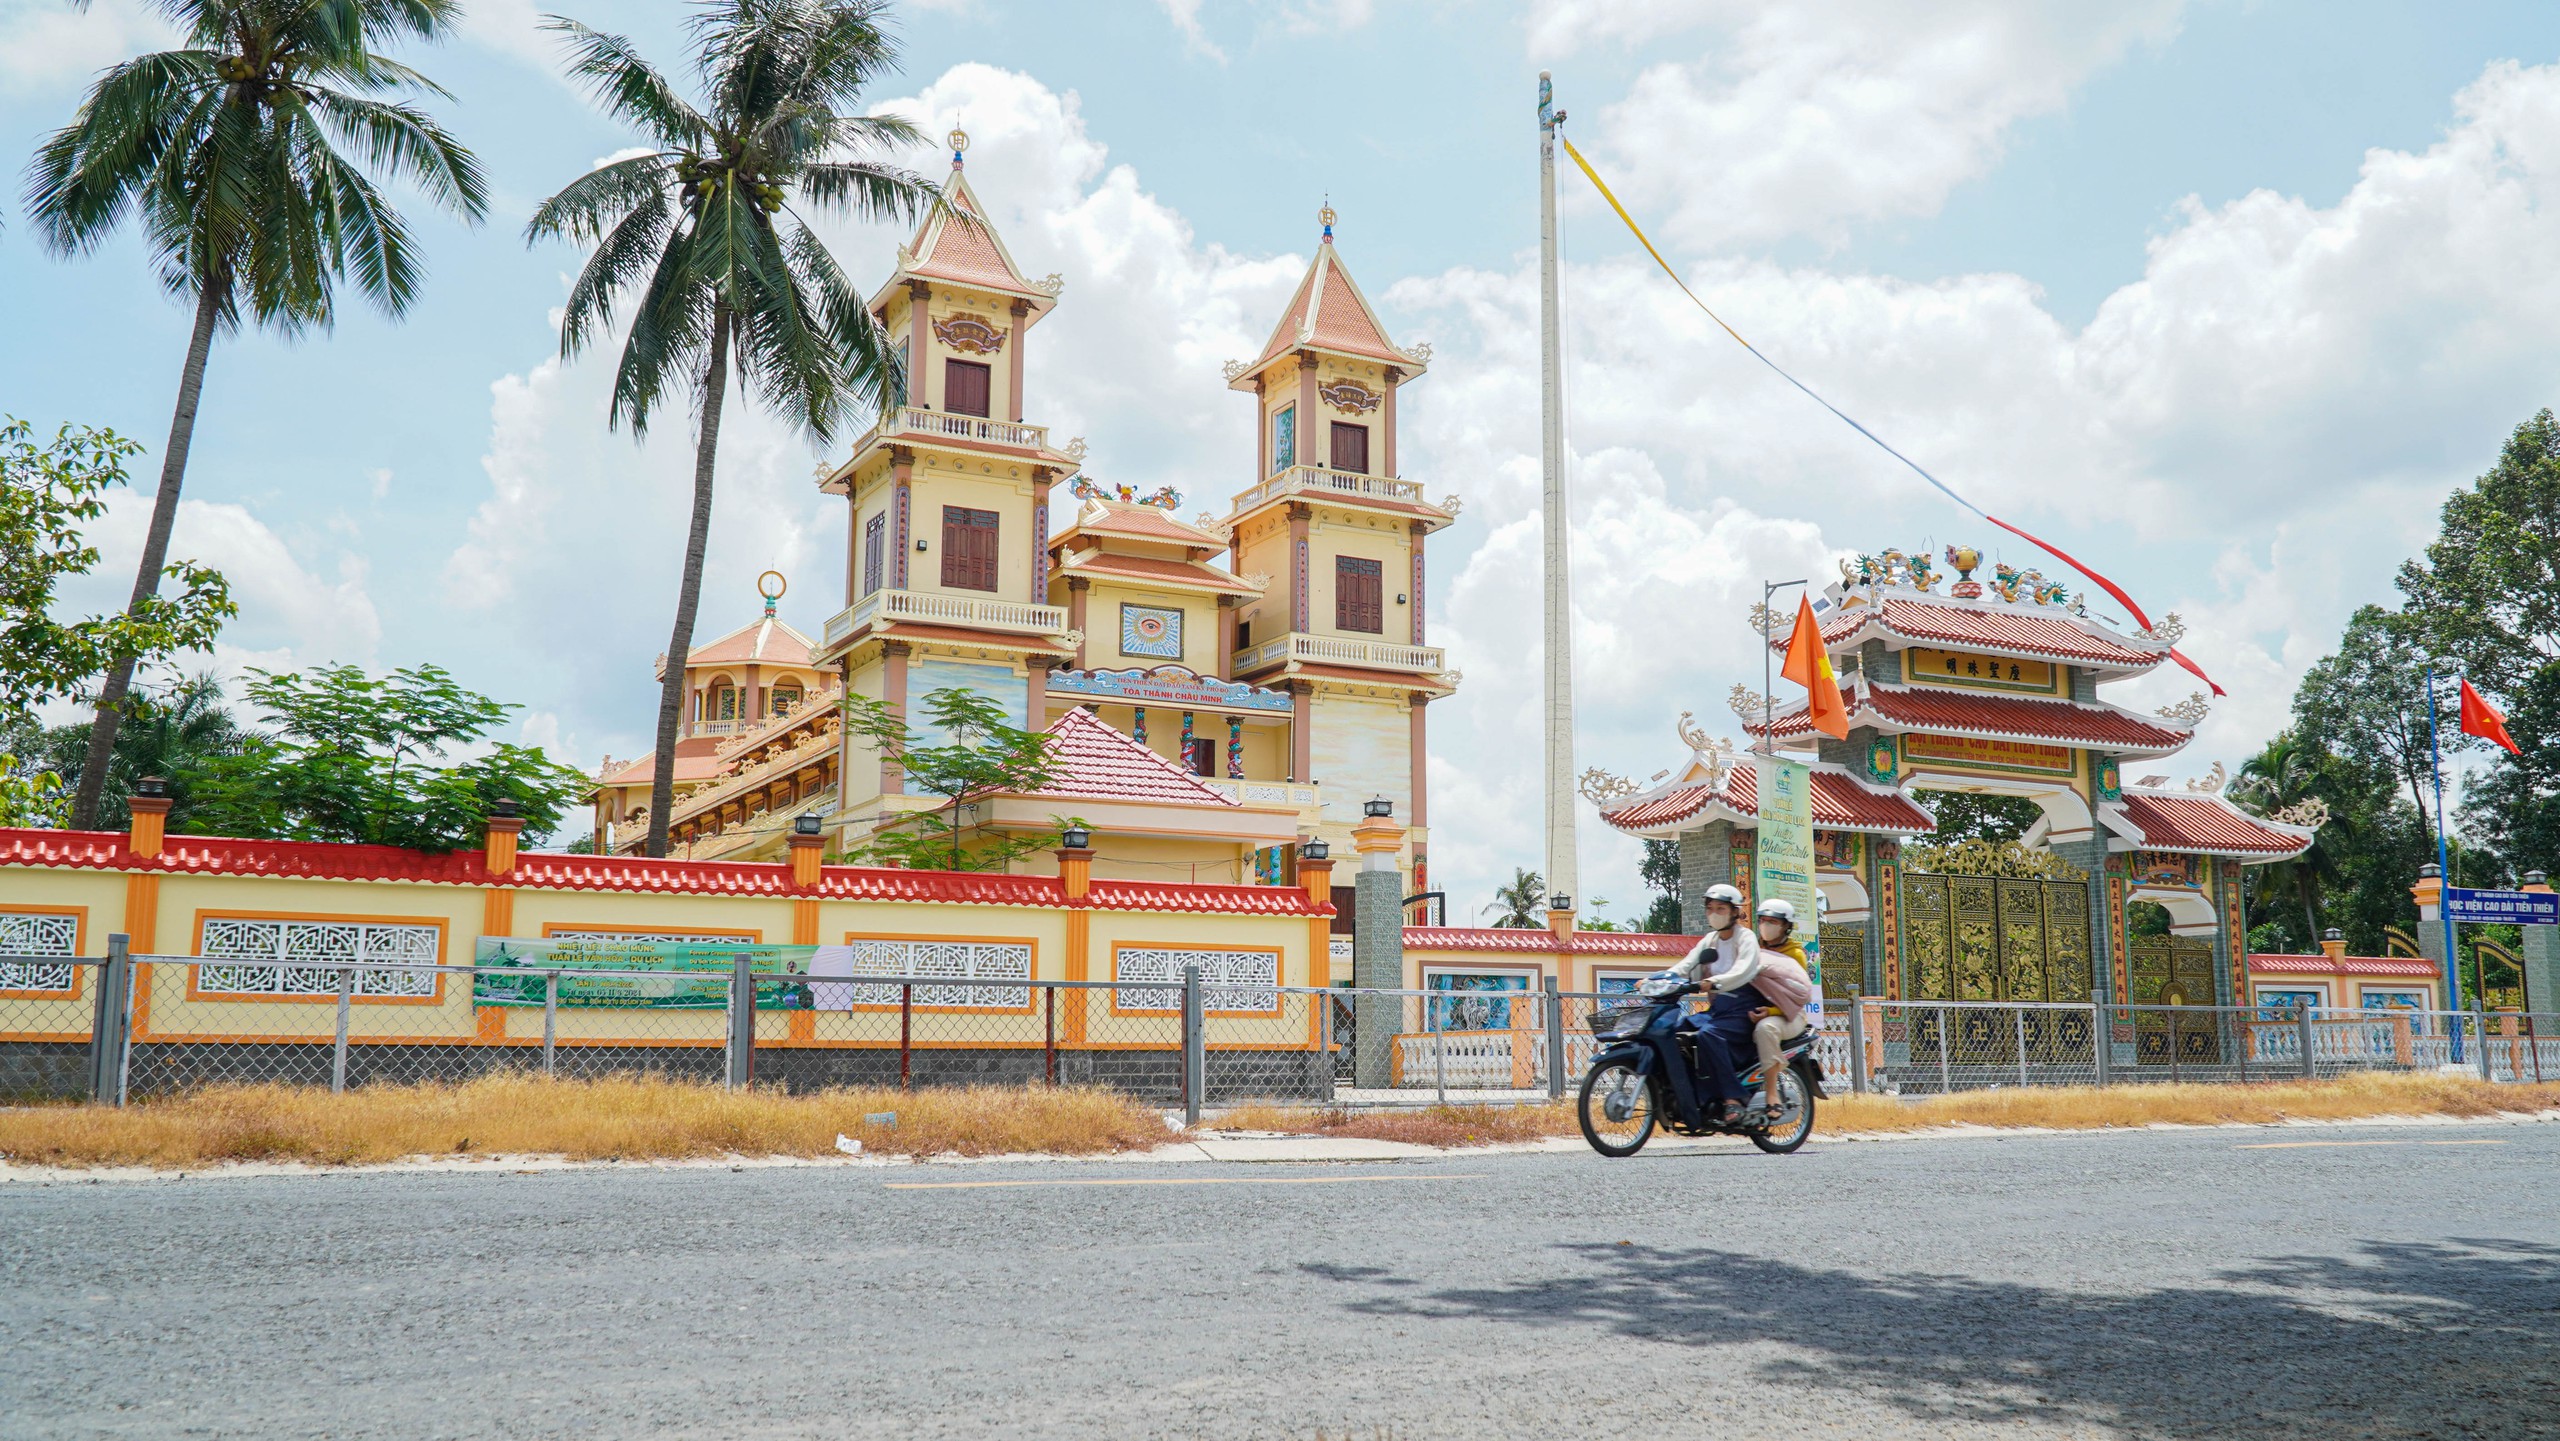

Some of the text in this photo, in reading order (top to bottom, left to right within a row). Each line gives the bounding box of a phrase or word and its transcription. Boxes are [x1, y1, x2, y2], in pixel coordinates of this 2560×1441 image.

[1143, 688, 1172, 699] THÁNH
[1200, 694, 1223, 703] MINH
[2465, 899, 2482, 912] VIỆN
[2484, 901, 2500, 912] CAO
[2501, 900, 2514, 912] ĐÀI
